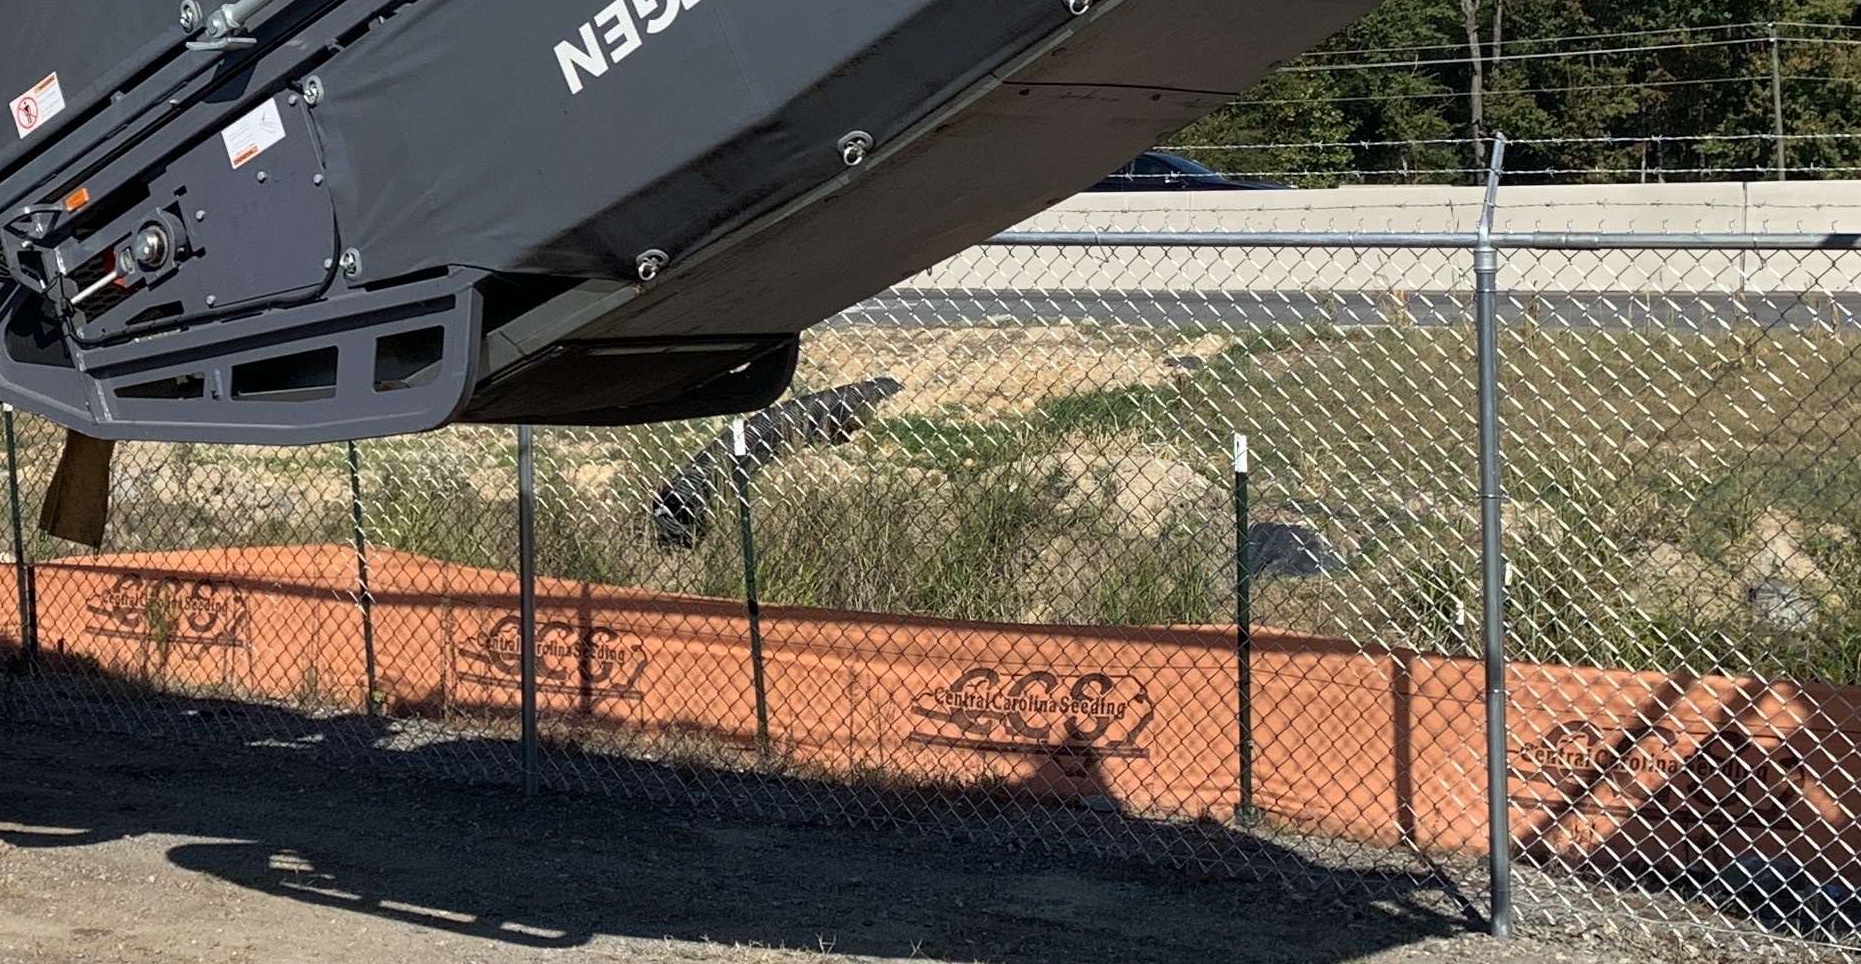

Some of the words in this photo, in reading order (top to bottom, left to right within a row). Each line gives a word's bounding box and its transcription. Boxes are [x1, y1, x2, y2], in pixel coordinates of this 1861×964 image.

[934, 686, 989, 709] Central
[991, 693, 1057, 714] Carolina
[1059, 695, 1127, 720] Seeding
